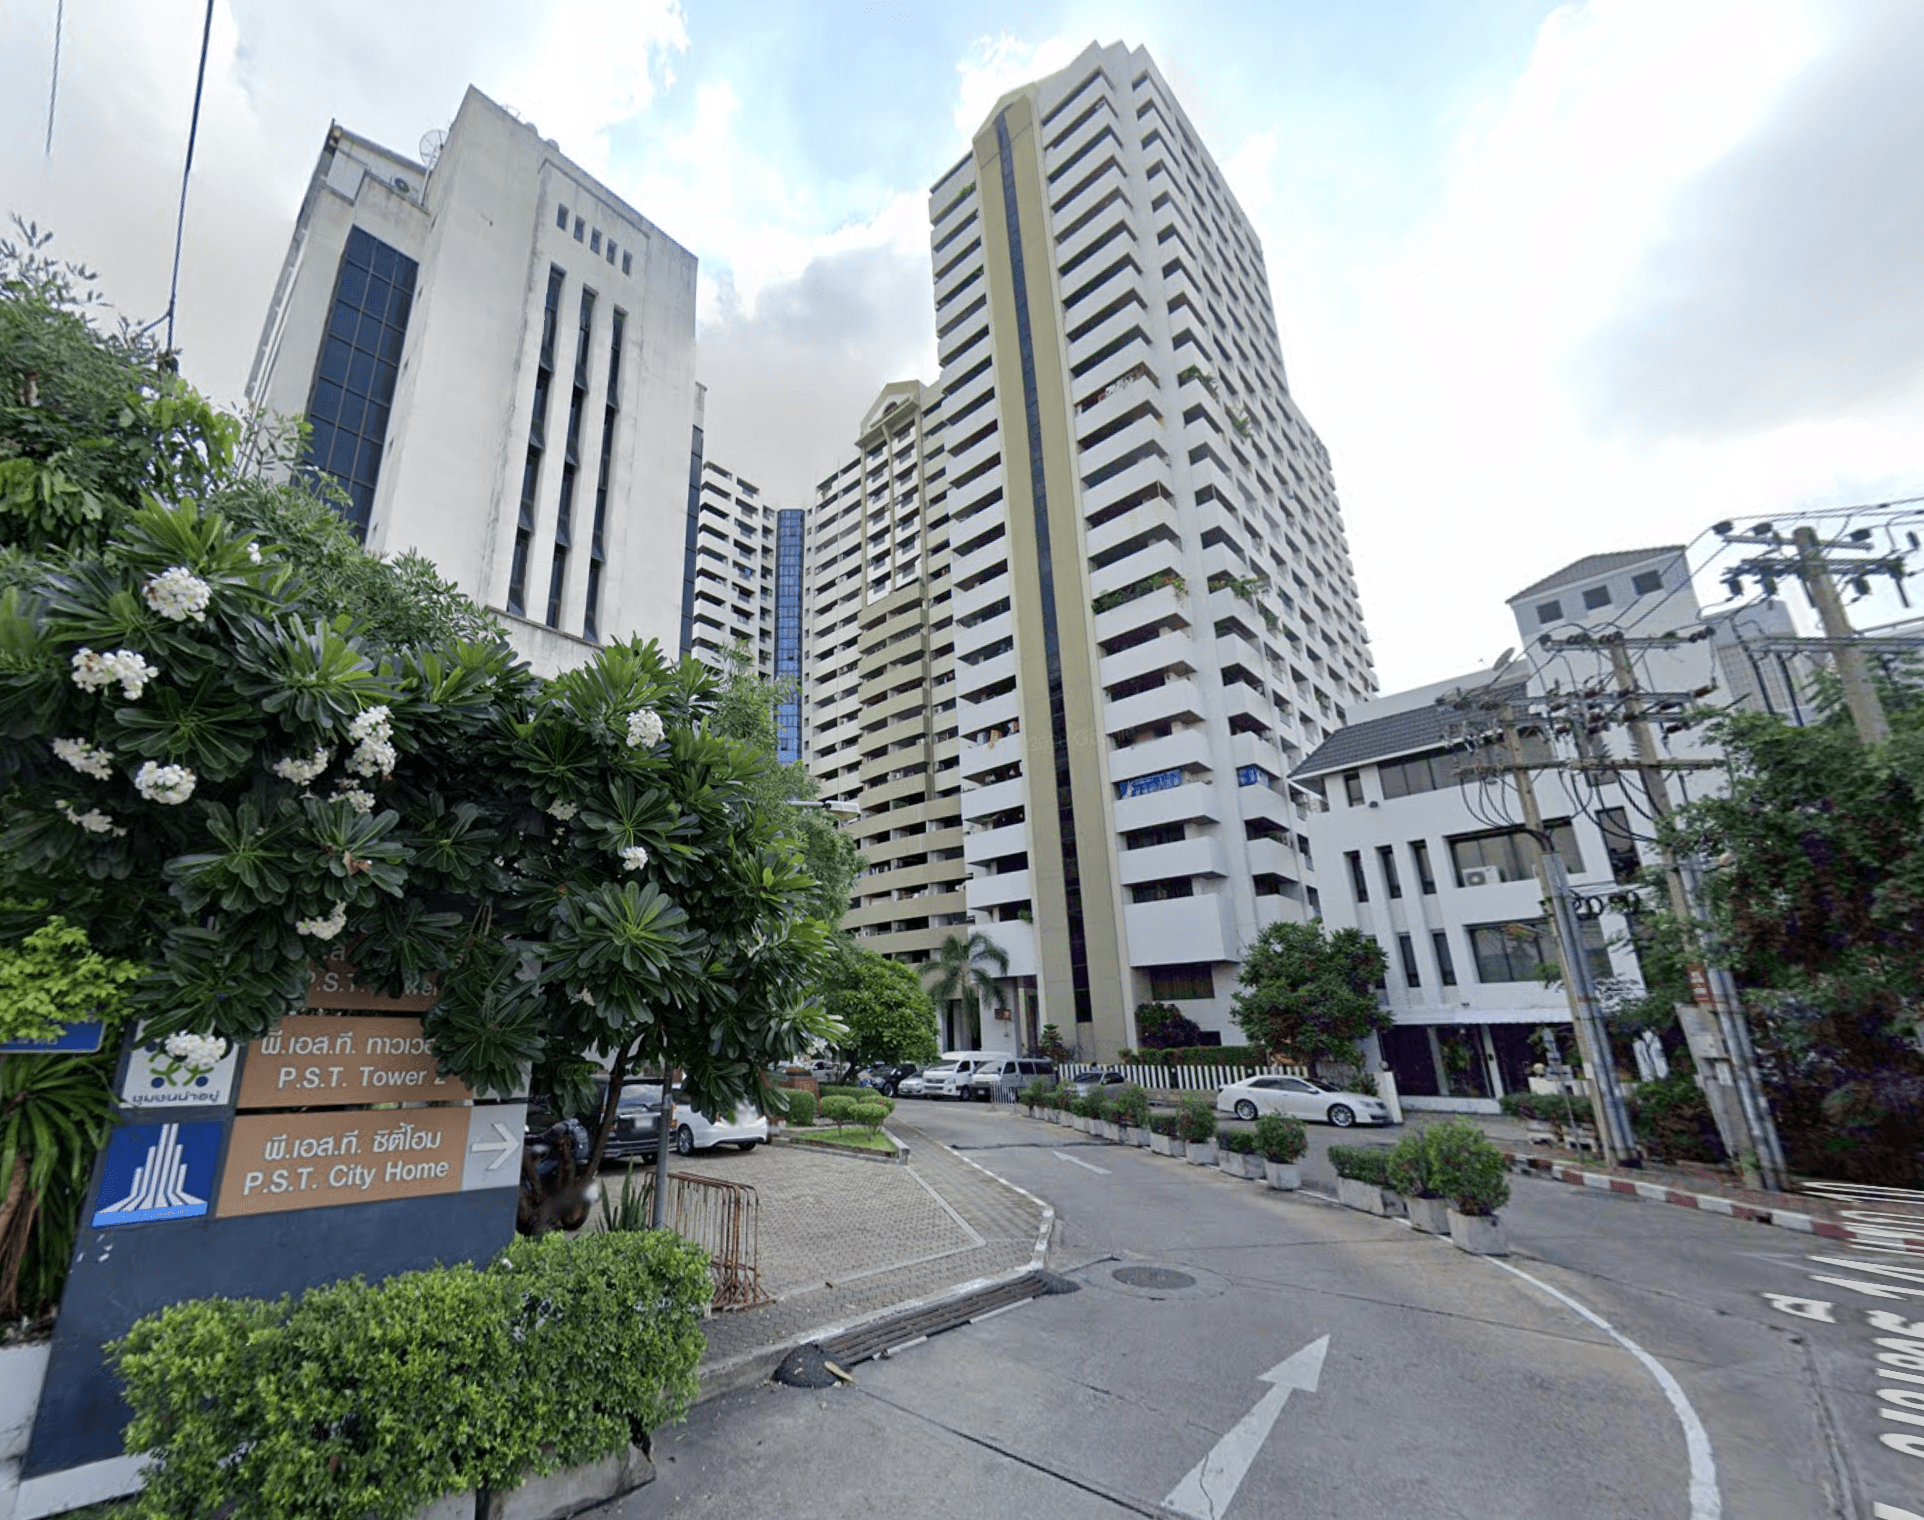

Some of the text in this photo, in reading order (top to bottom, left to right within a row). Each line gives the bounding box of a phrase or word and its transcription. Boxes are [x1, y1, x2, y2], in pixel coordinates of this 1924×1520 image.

[277, 1066, 348, 1089] P.S.T.
[359, 1065, 428, 1087] Tower
[263, 1122, 442, 1161] พี.เอส.ที. ซิตี้โฮม
[242, 1160, 450, 1196] P.S.T. City Home
